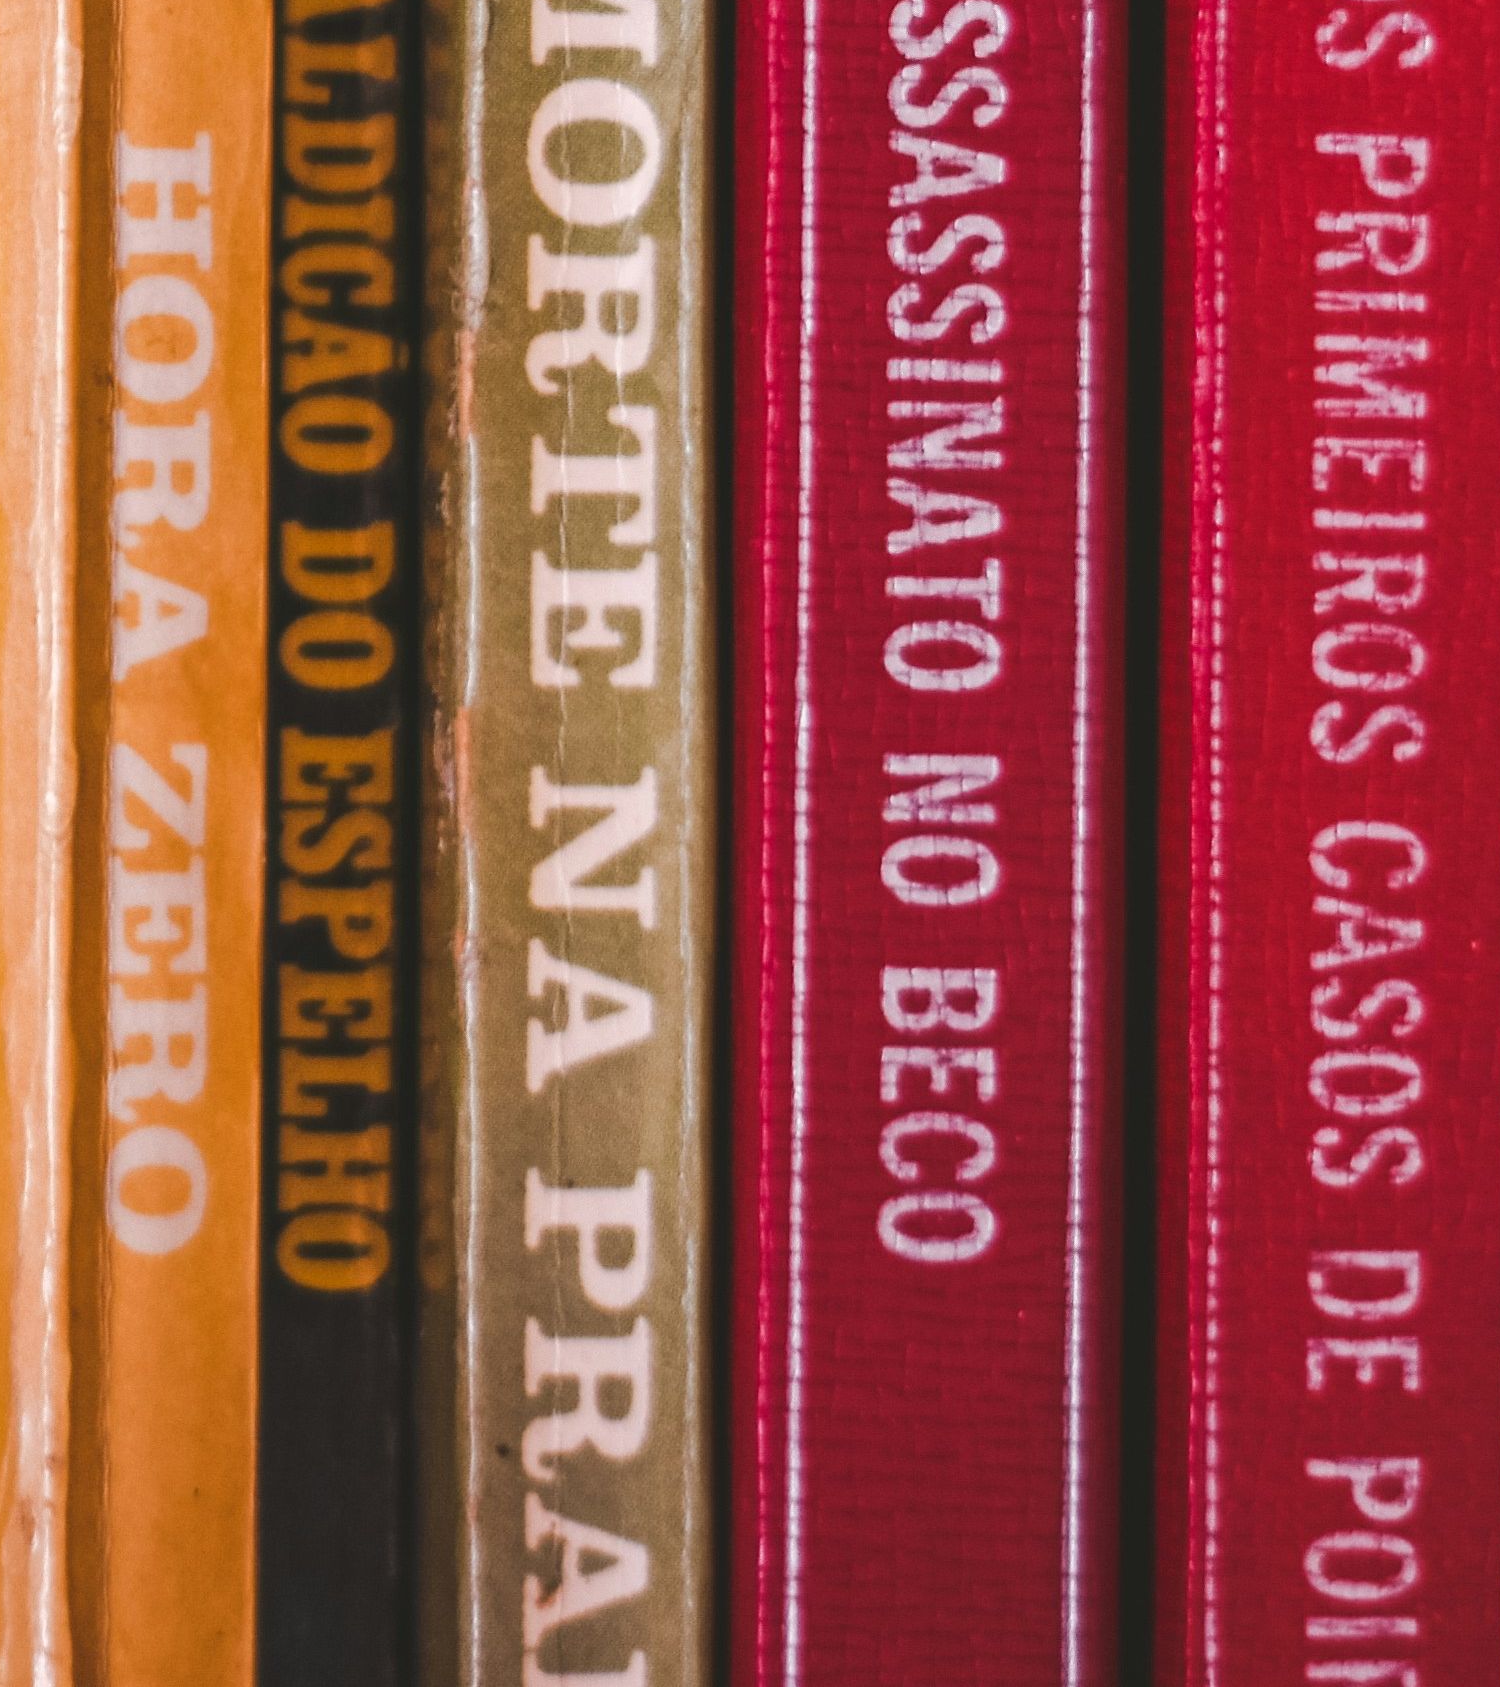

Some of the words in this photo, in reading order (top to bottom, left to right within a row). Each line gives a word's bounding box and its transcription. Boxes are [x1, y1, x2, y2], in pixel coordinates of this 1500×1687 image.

[110, 130, 216, 683] HORA
[1307, 130, 1429, 768] PRIMEIROS
[281, 518, 396, 689] DO
[105, 740, 210, 1257] ZERO
[524, 765, 660, 1095] NA
[879, 751, 1001, 909] NO
[277, 727, 396, 1293] ESPELHO
[875, 969, 1000, 1267] BECO
[1305, 820, 1427, 1191] CASOS
[1303, 1247, 1424, 1393] DE
